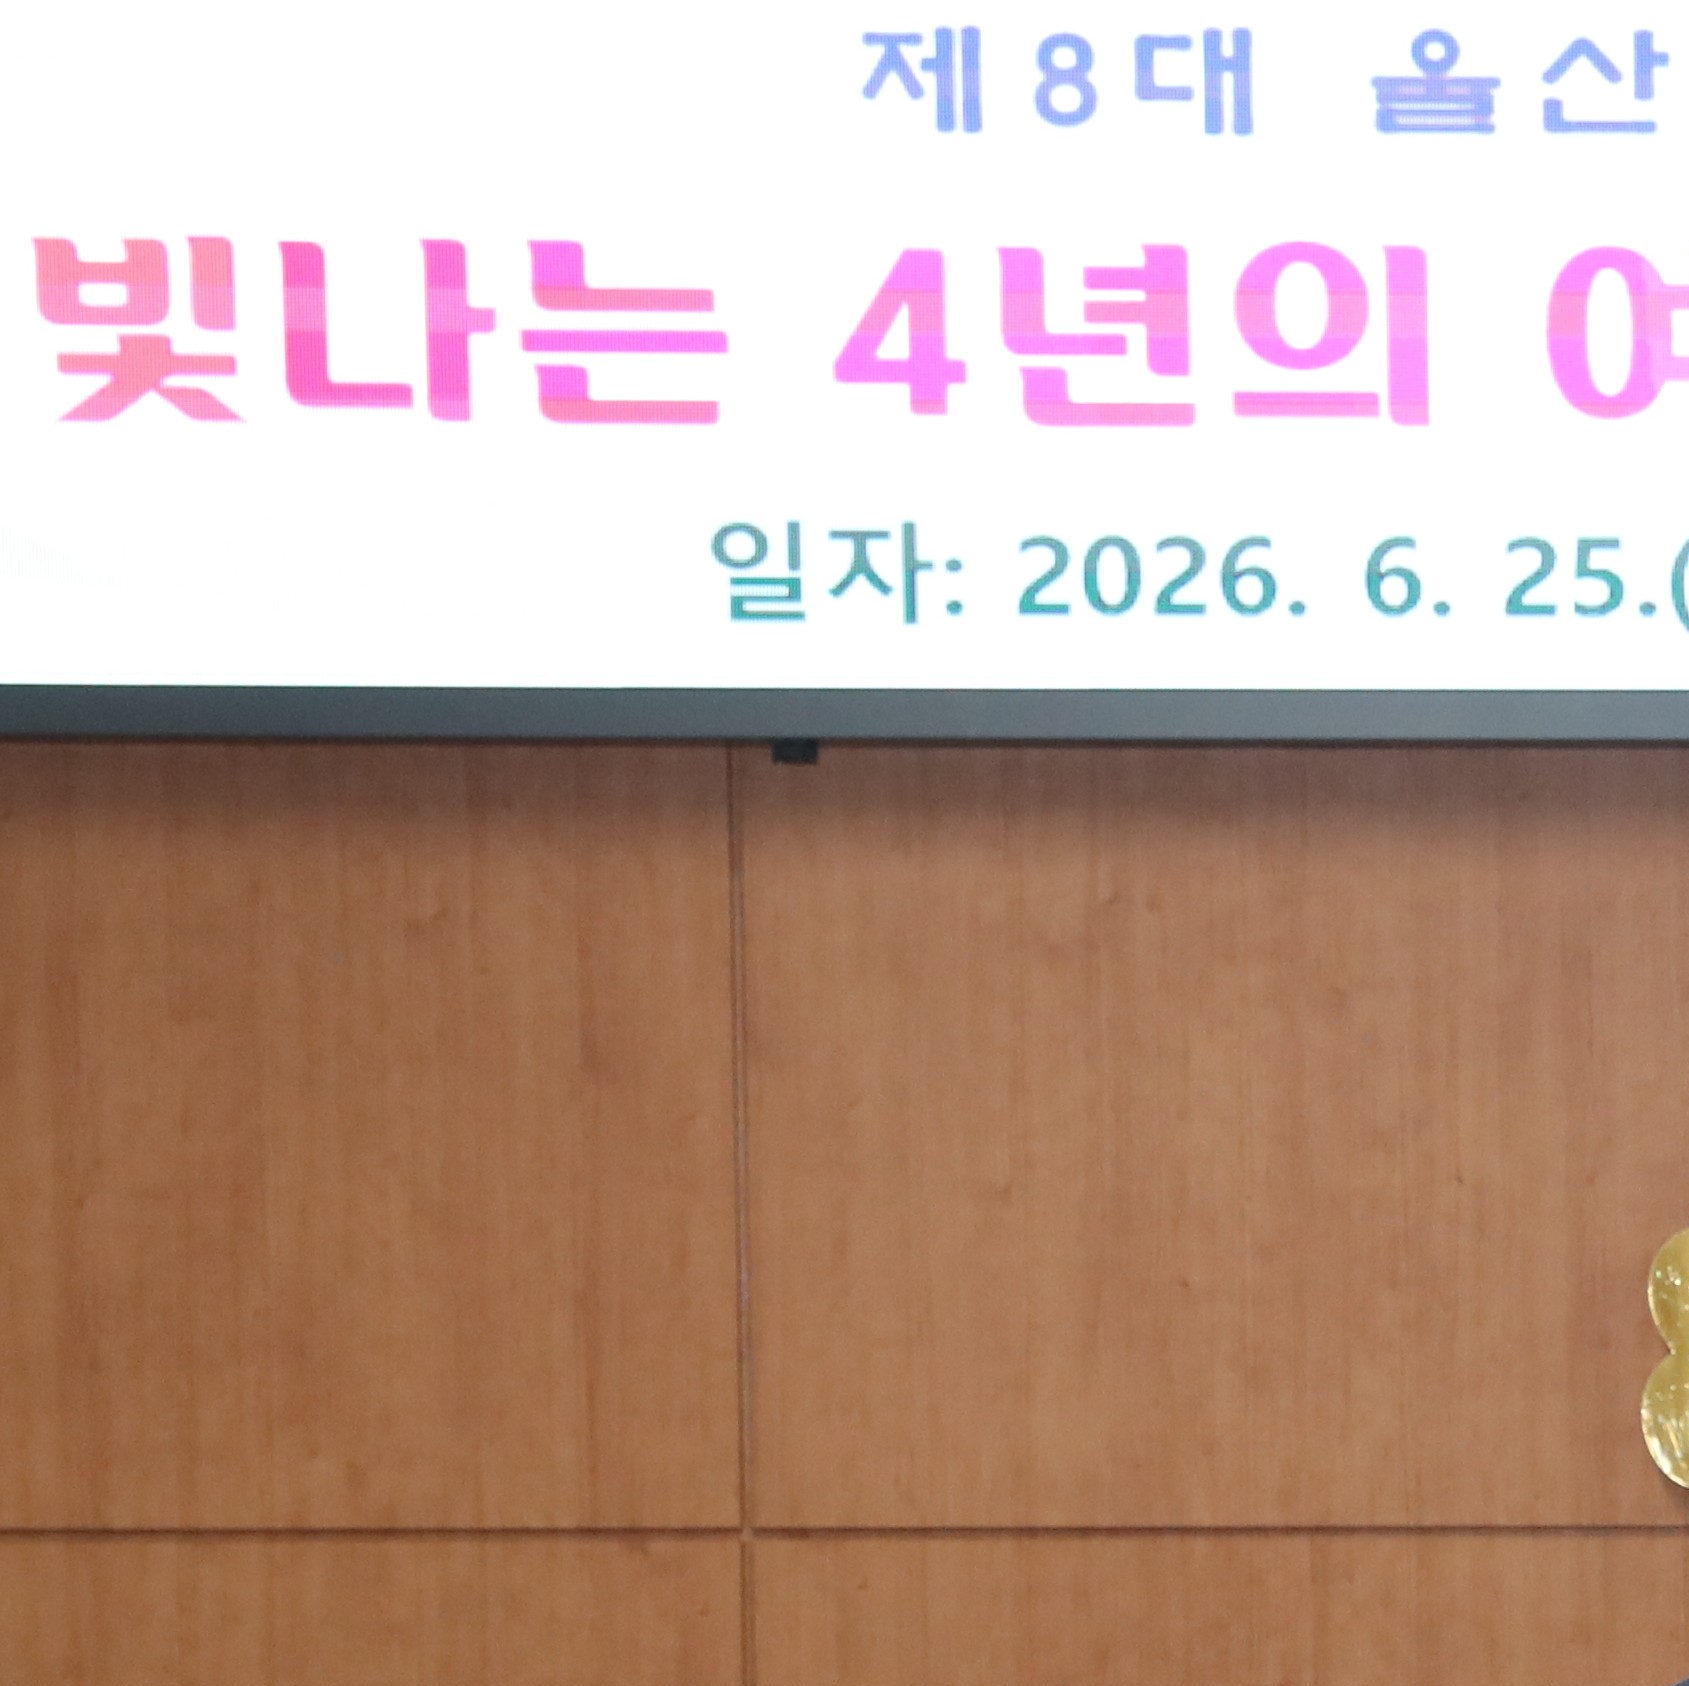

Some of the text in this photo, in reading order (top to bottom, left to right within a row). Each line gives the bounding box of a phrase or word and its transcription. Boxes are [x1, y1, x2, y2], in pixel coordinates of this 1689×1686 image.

[861, 25, 1254, 138] 제8대
[30, 234, 730, 427] 빛나는
[831, 239, 1431, 429] 4년의
[710, 519, 964, 625] 일자:
[1018, 534, 1307, 618] 2026.
[1364, 535, 1451, 618] 6.
